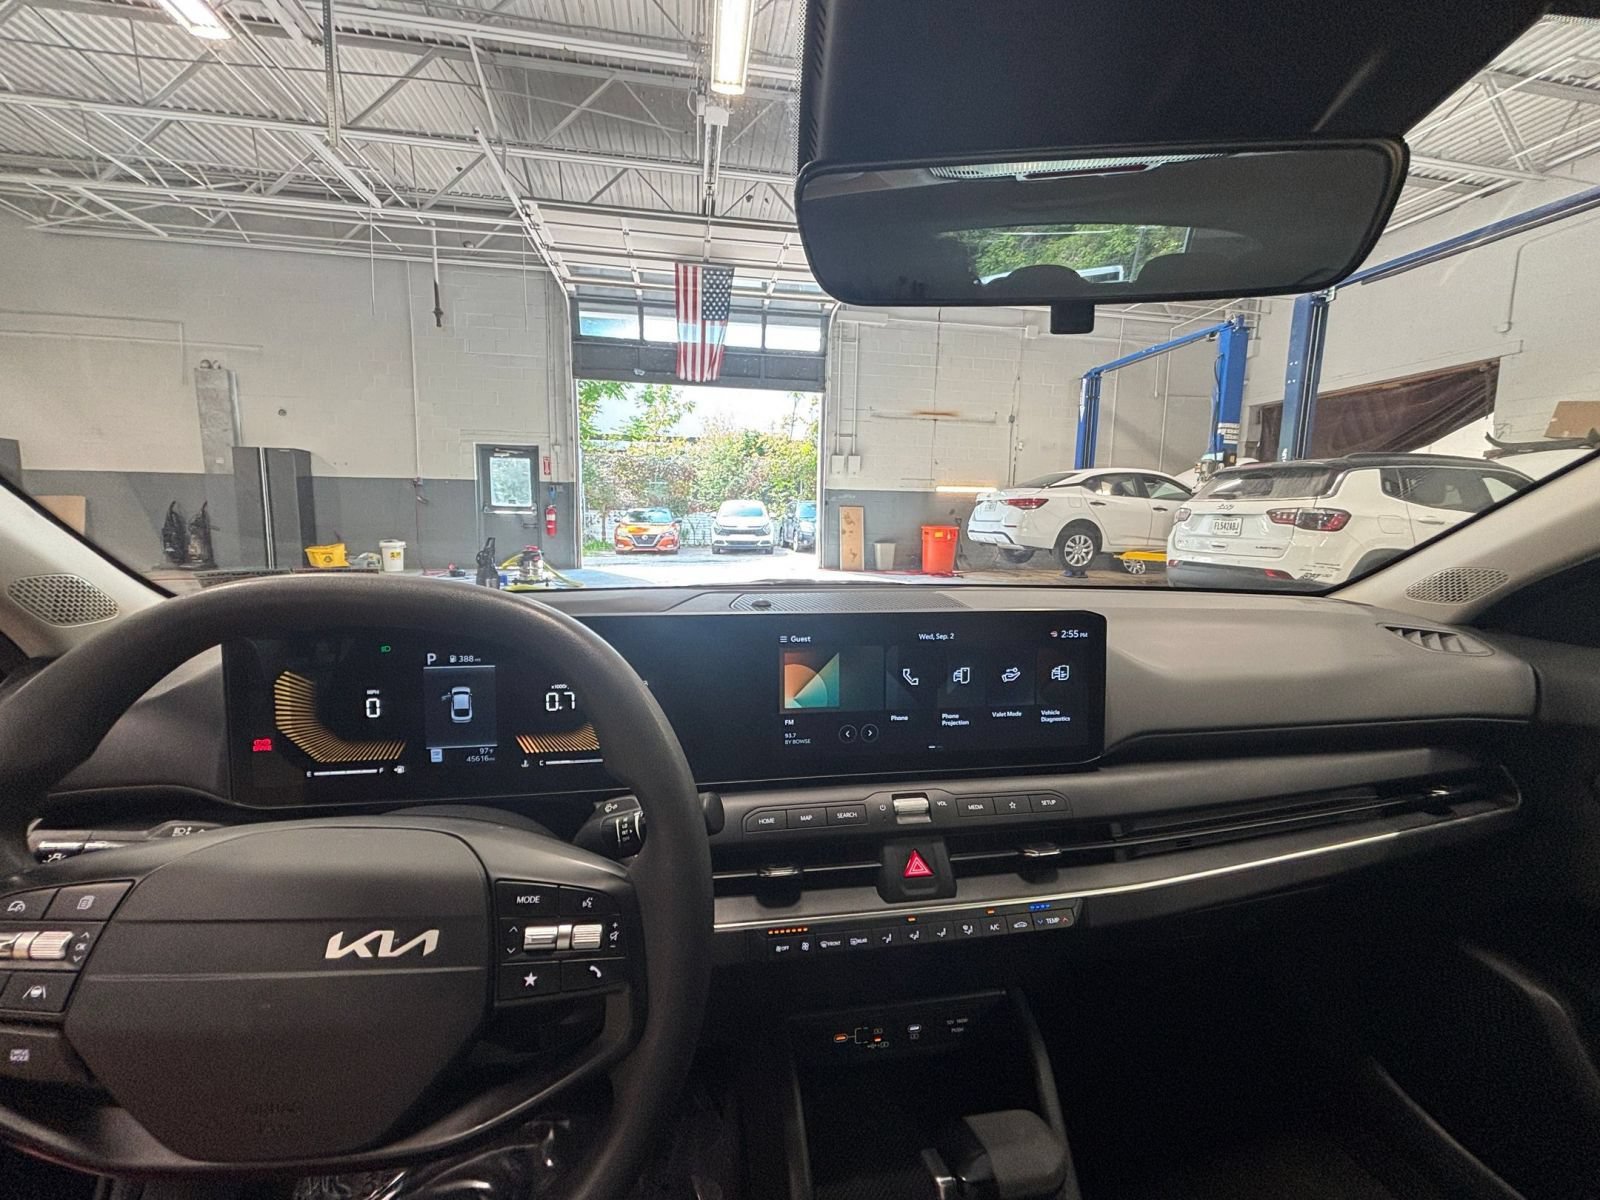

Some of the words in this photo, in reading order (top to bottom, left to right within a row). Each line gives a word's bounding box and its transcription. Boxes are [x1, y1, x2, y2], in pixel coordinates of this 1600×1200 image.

[918, 633, 934, 641] Wed,
[935, 632, 949, 641] Sep.
[949, 632, 955, 640] 2
[1061, 629, 1079, 639] 2:55
[790, 635, 811, 643] Guest
[427, 653, 437, 666] P
[458, 655, 474, 663] 388
[545, 692, 576, 711] 0.7
[967, 803, 984, 811] MEDIA
[1040, 799, 1057, 807] SETUP
[836, 811, 858, 819] SEARCH
[758, 817, 776, 825] HOME
[516, 895, 541, 904] MODE
